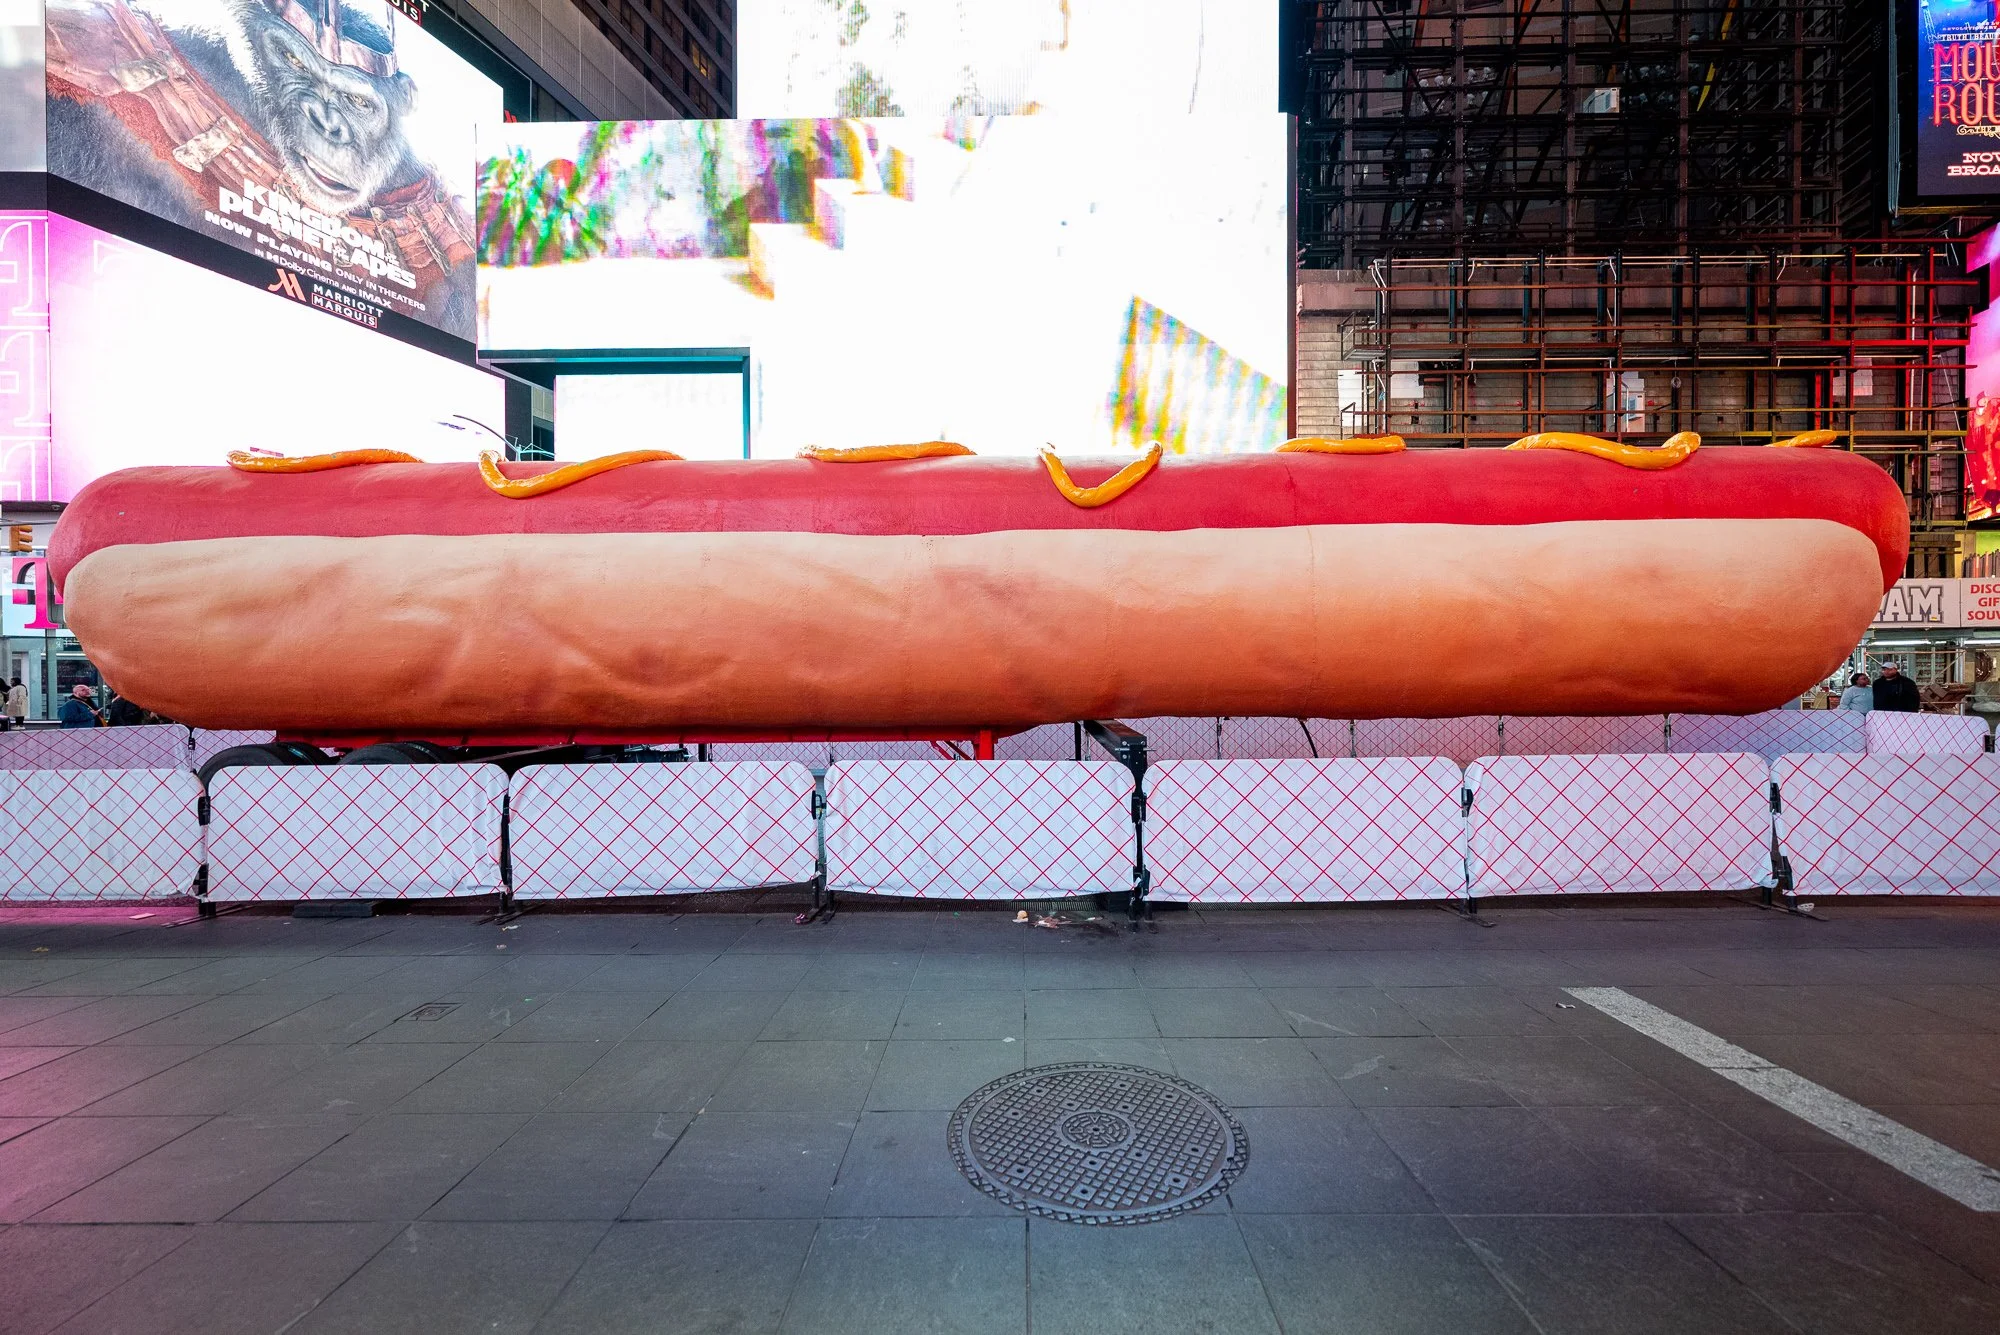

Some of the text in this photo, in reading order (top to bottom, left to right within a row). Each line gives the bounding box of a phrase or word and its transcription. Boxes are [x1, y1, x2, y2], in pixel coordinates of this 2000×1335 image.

[218, 186, 337, 254] PLANET
[350, 248, 417, 289] APES
[243, 177, 385, 261] KINGDOM
[204, 210, 426, 310] NOW PLAYING ONLY IN THEATERS
[254, 248, 392, 309] IN Dolby Cinema AND IMAX
[313, 283, 384, 318] MARRIOTT
[313, 295, 376, 326] MARQUIS
[1873, 586, 1944, 624] AM
[1978, 597, 2000, 607] GIF
